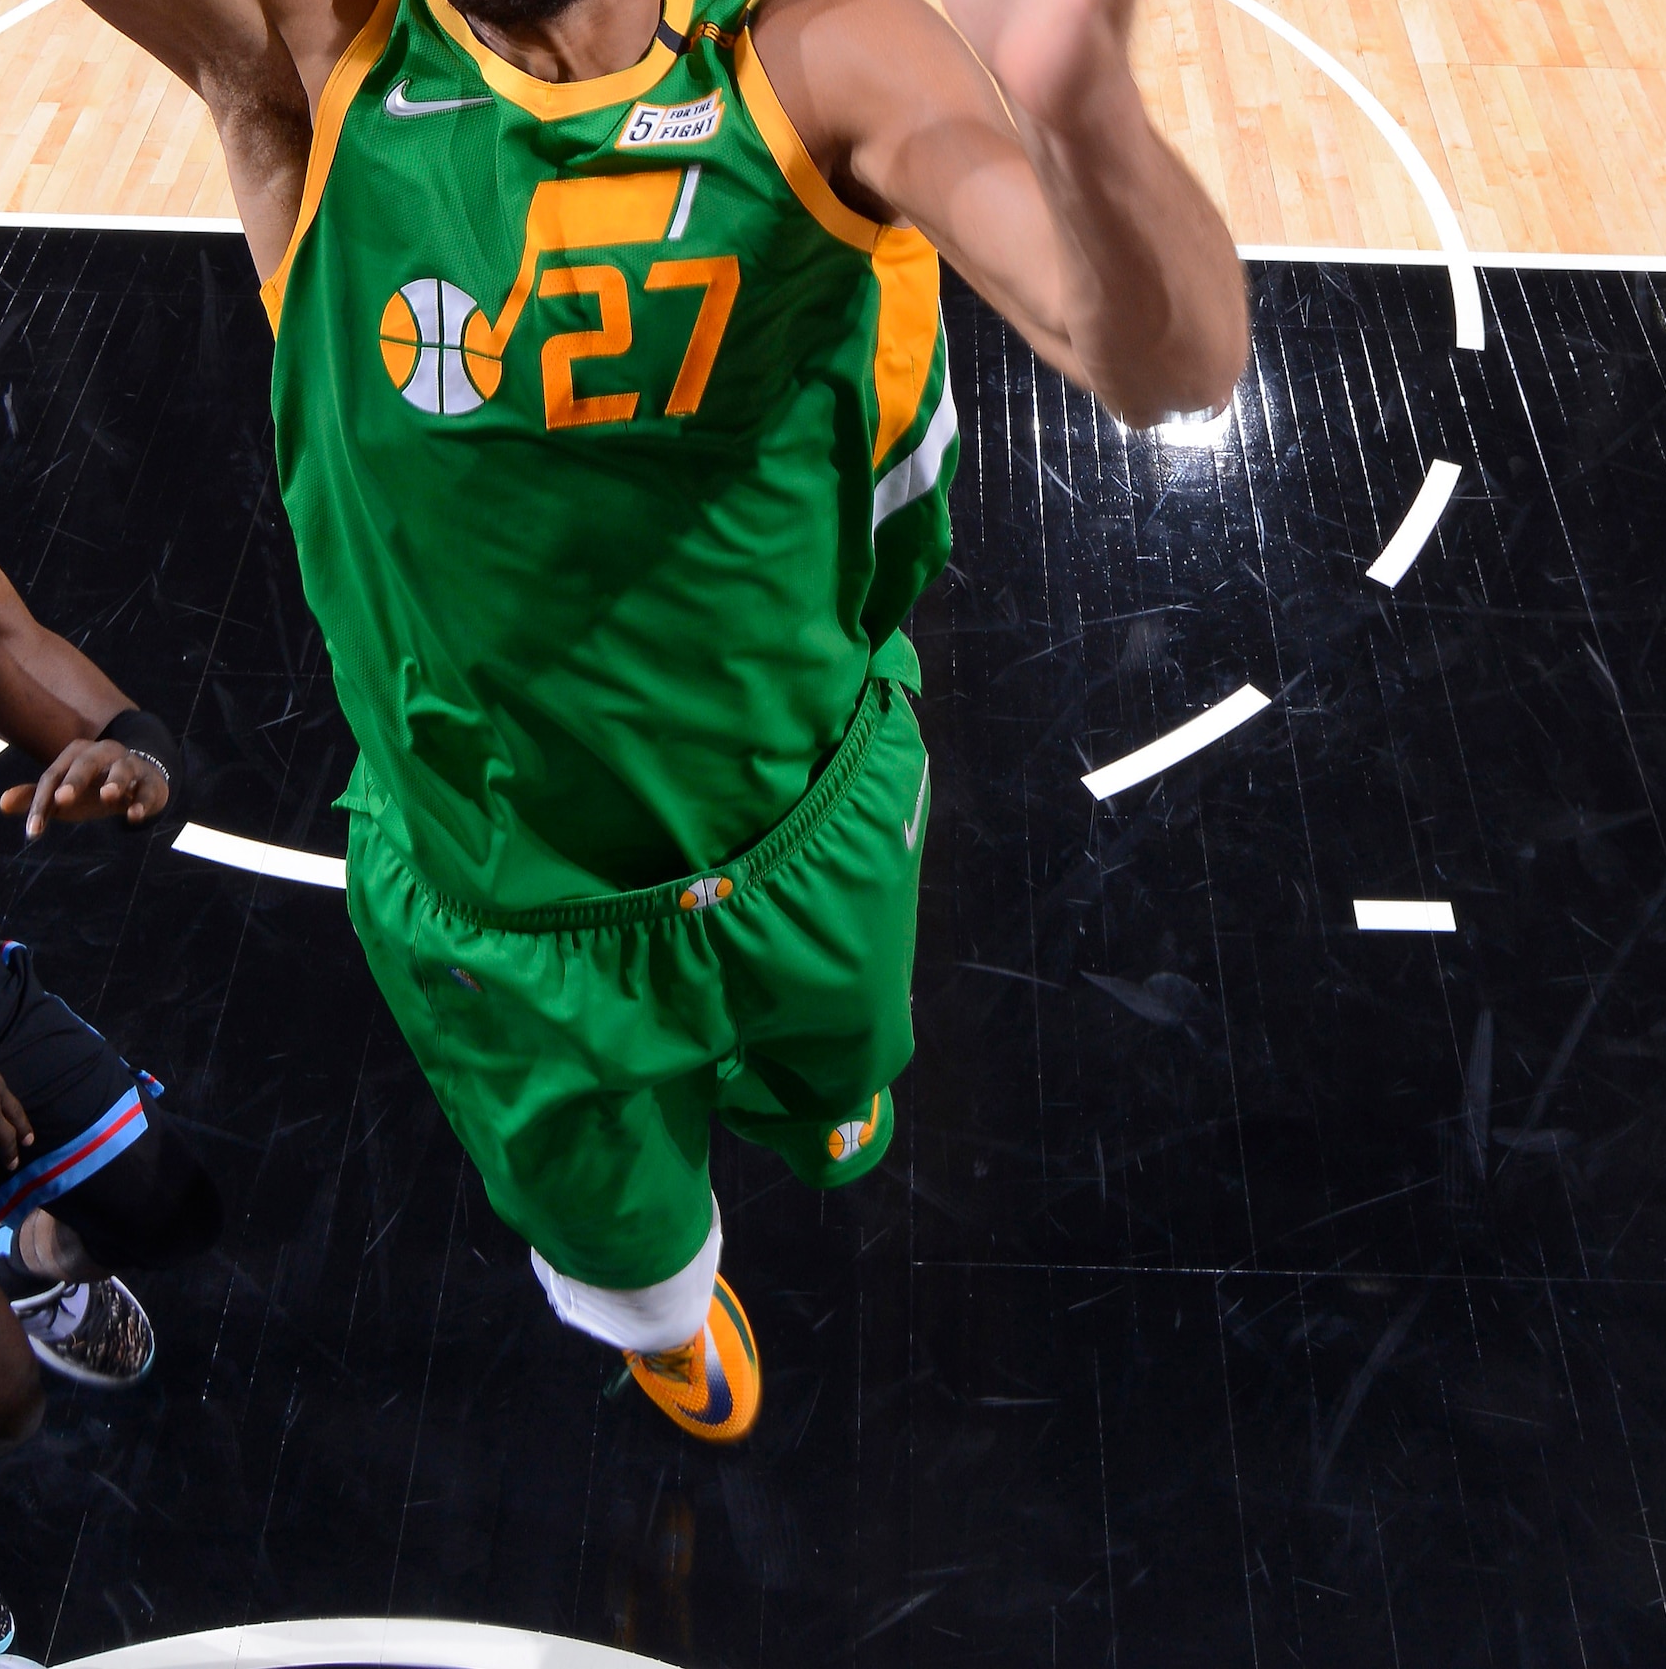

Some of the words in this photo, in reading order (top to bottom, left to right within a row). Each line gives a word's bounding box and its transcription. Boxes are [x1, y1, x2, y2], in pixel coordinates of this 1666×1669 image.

[628, 109, 659, 142] 5
[669, 108, 692, 120] FOR
[693, 99, 713, 116] THE
[659, 114, 716, 140] FIGHT
[537, 254, 740, 431] 27
